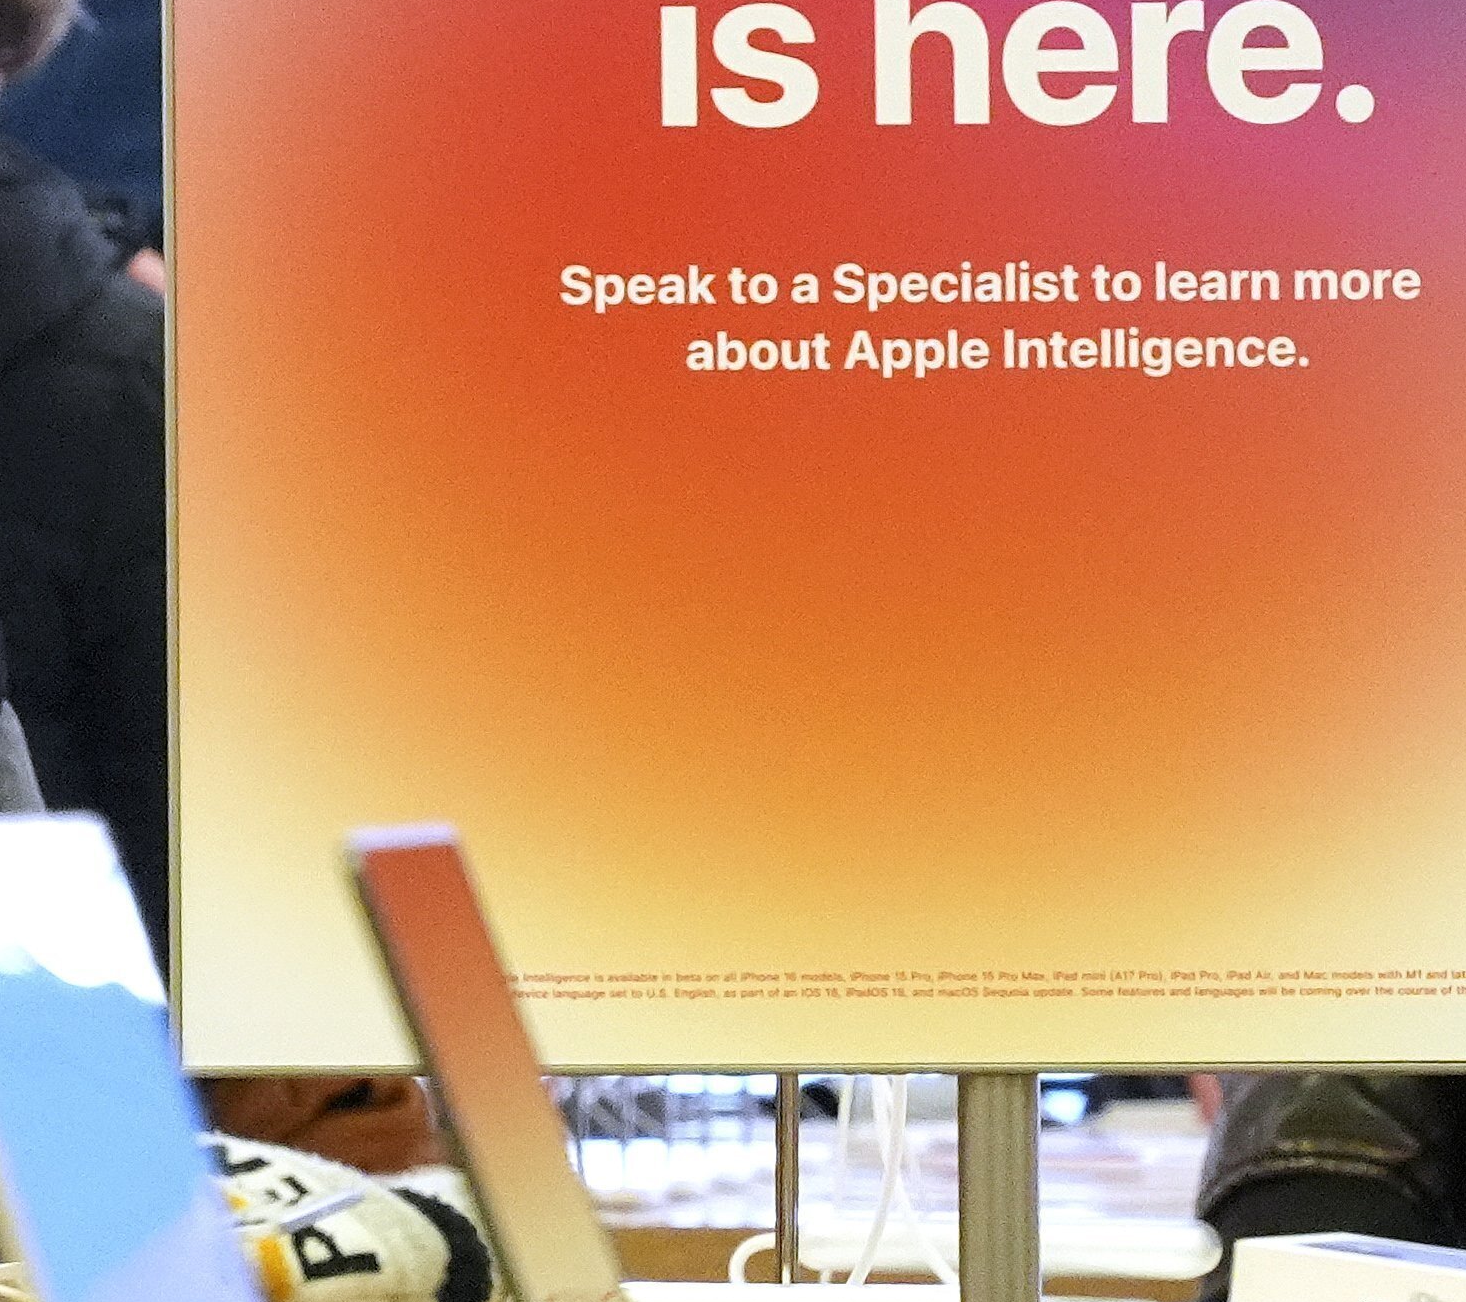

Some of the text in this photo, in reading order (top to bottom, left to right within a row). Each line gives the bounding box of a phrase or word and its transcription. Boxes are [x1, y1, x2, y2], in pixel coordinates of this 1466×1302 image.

[560, 260, 1422, 312] Speak to a Specialist to learn more
[685, 326, 1310, 379] about Apple Intelligence.
